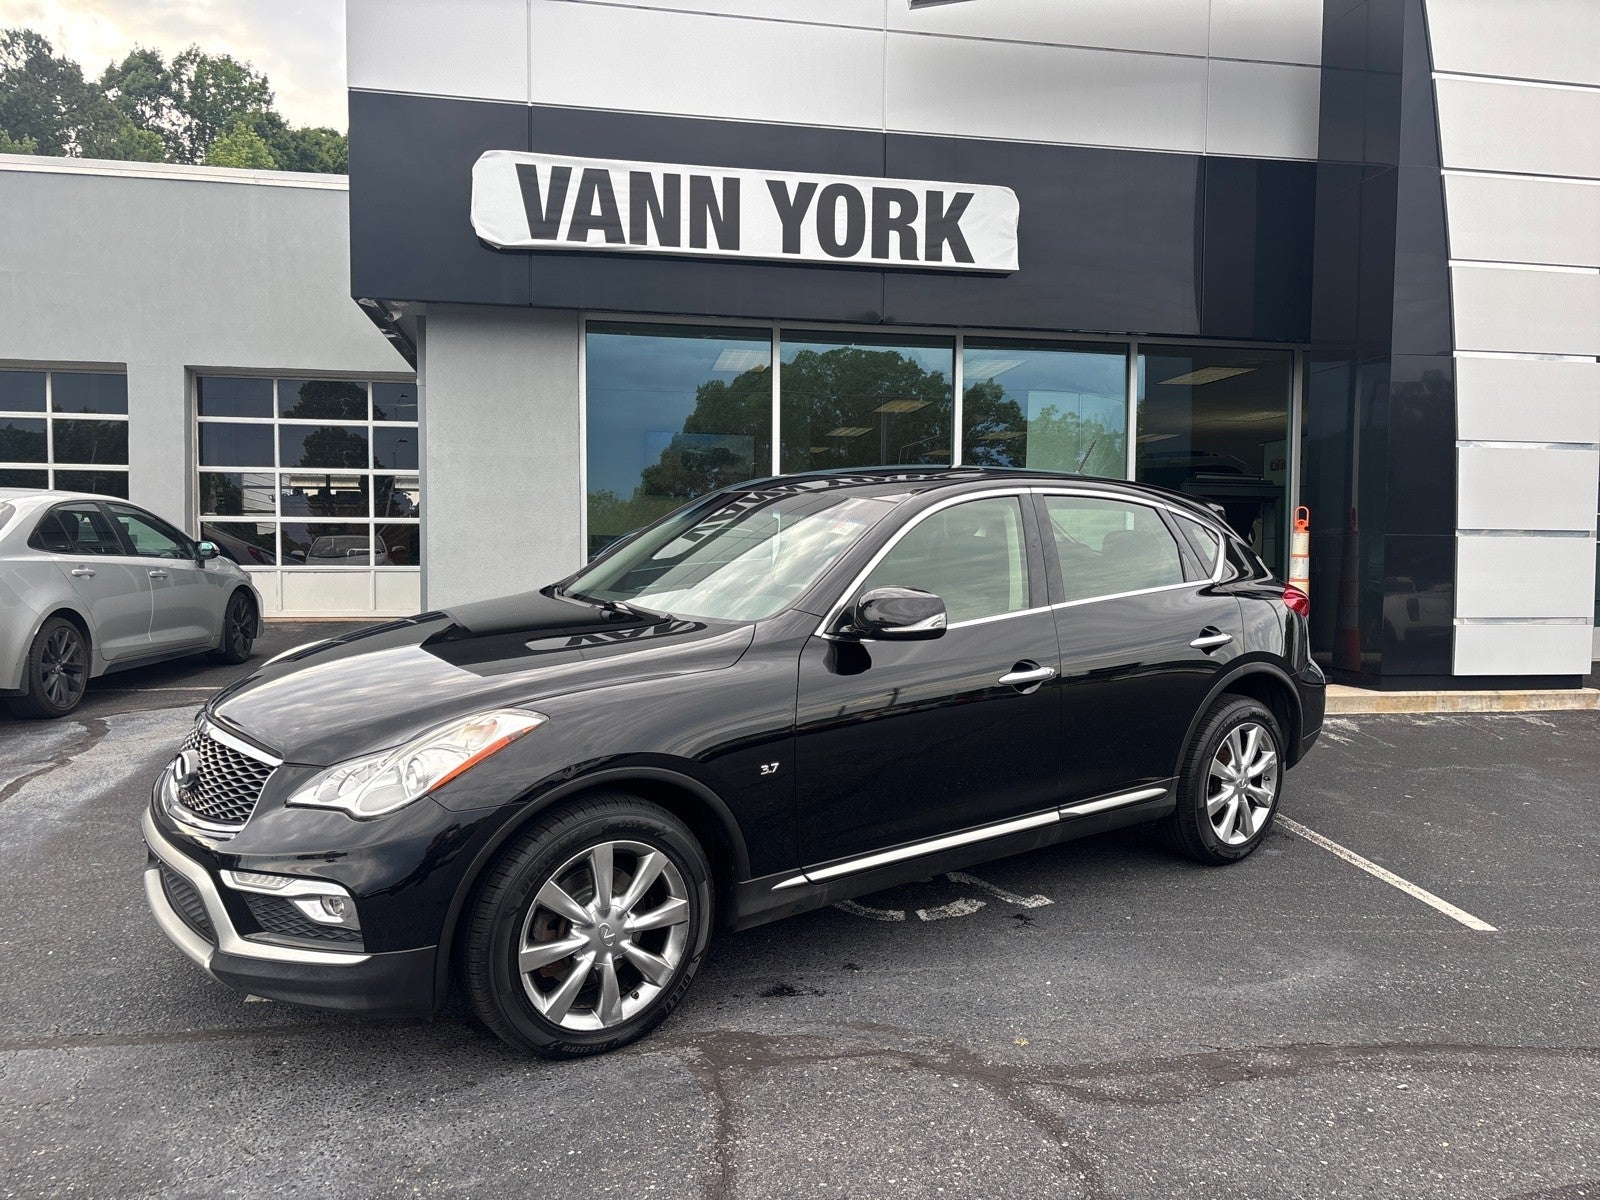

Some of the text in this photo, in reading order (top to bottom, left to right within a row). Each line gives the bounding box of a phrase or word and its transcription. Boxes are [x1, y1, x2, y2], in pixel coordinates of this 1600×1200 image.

[515, 163, 975, 264] VANN YORK
[760, 762, 780, 776] 3.7
